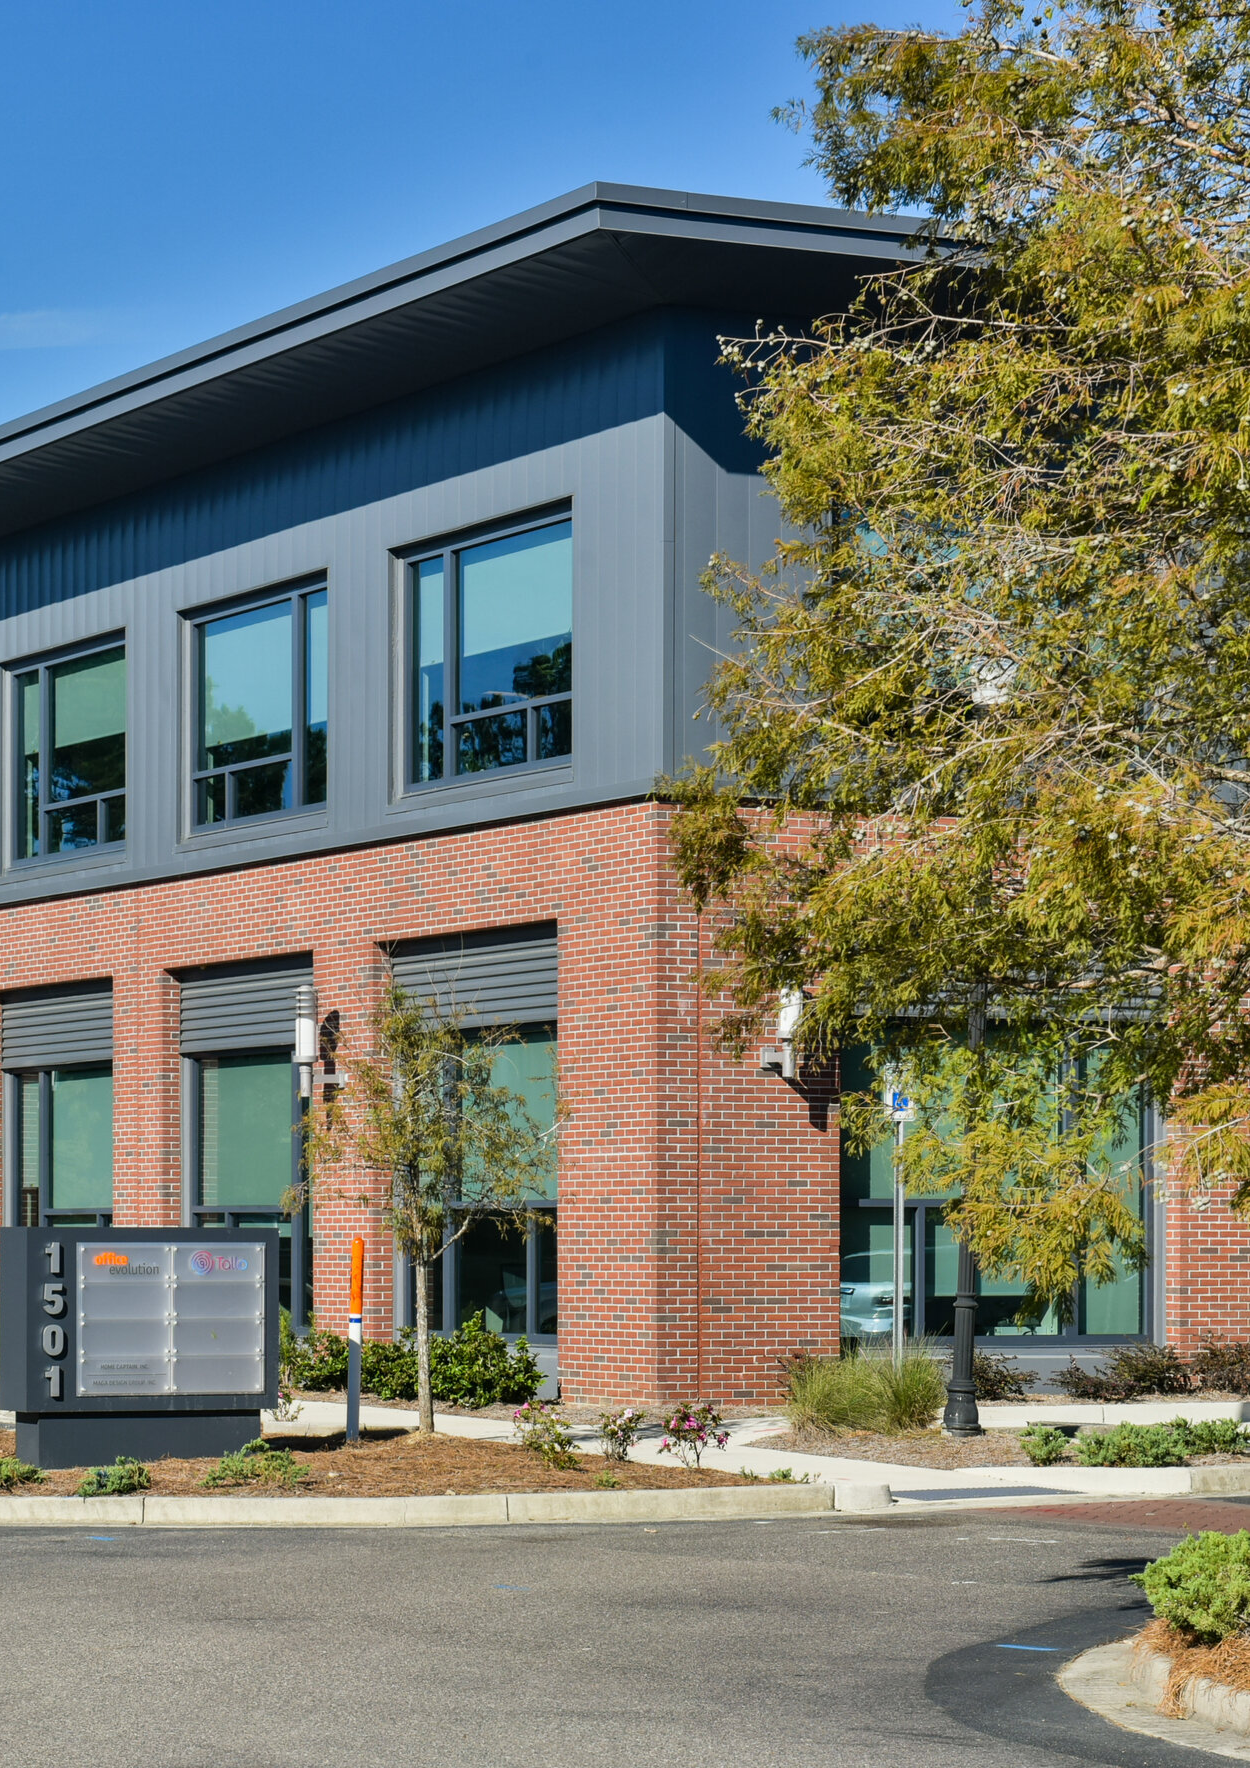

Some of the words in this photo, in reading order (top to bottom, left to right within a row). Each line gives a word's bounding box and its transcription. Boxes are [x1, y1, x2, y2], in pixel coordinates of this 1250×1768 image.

[95, 1252, 128, 1266] office
[216, 1256, 248, 1270] Tallo
[109, 1263, 160, 1275] evolution
[43, 1242, 64, 1397] 1501
